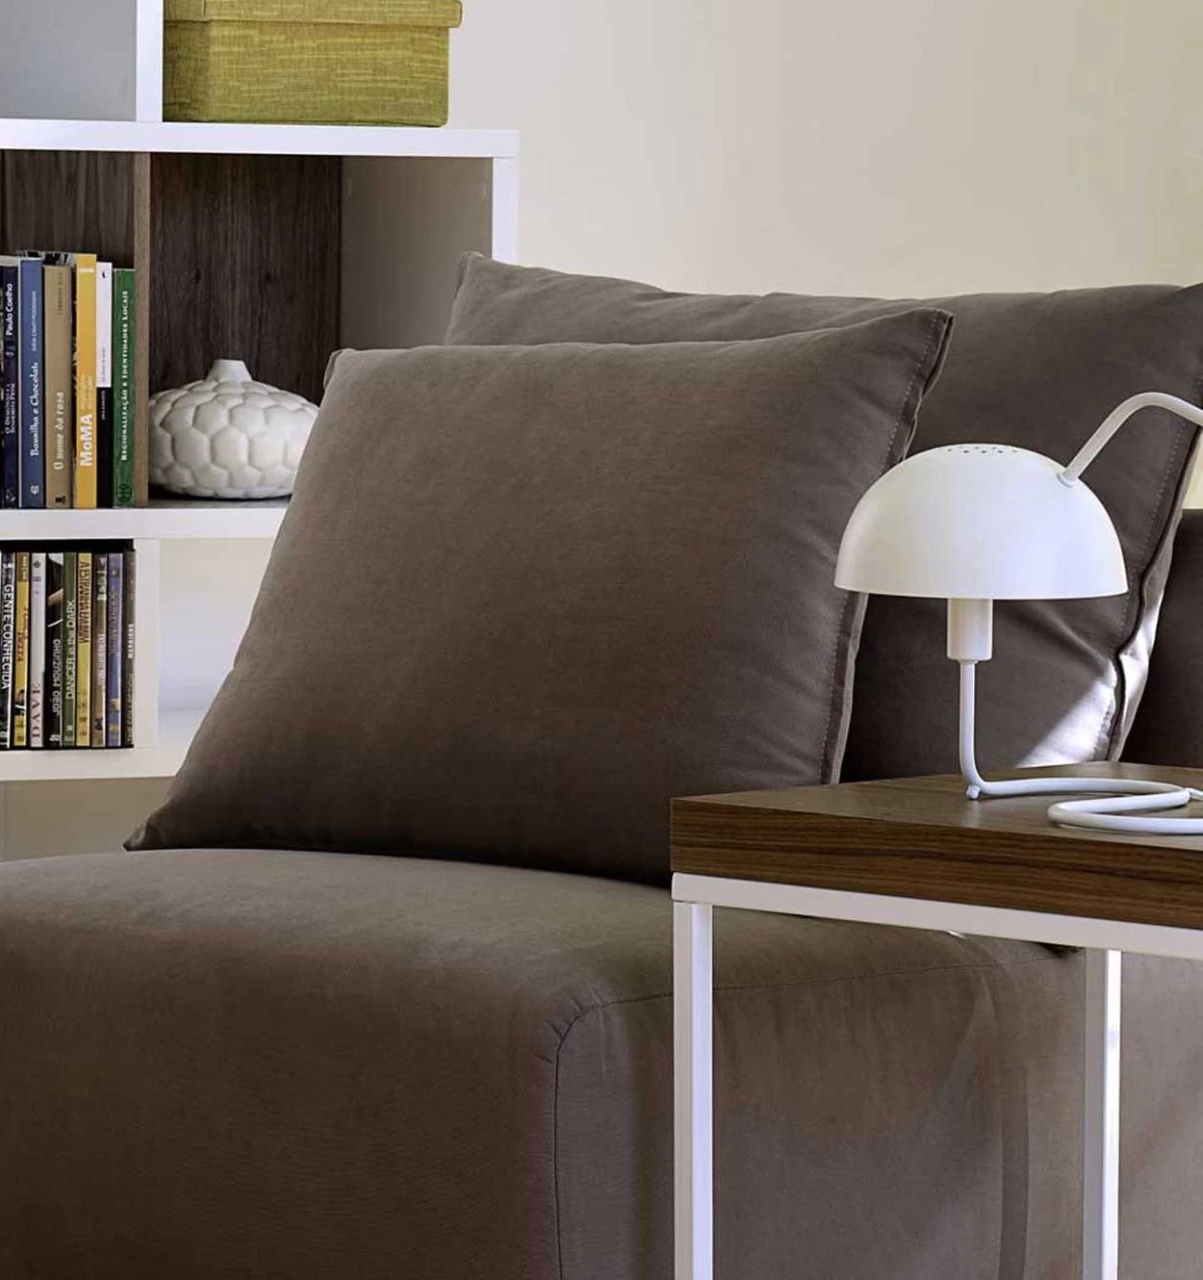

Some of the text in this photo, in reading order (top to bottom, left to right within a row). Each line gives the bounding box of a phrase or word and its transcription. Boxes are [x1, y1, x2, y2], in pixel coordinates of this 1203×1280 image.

[6, 283, 14, 336] Paulo Coelho
[56, 392, 64, 415] rosa
[55, 433, 64, 459] nome
[80, 413, 93, 466] MoMA
[54, 462, 64, 470] O
[67, 600, 75, 627] DARK
[1, 584, 12, 689] GENTE CONHECIDA
[66, 657, 75, 699] DANCER
[32, 683, 41, 738] DAVE
